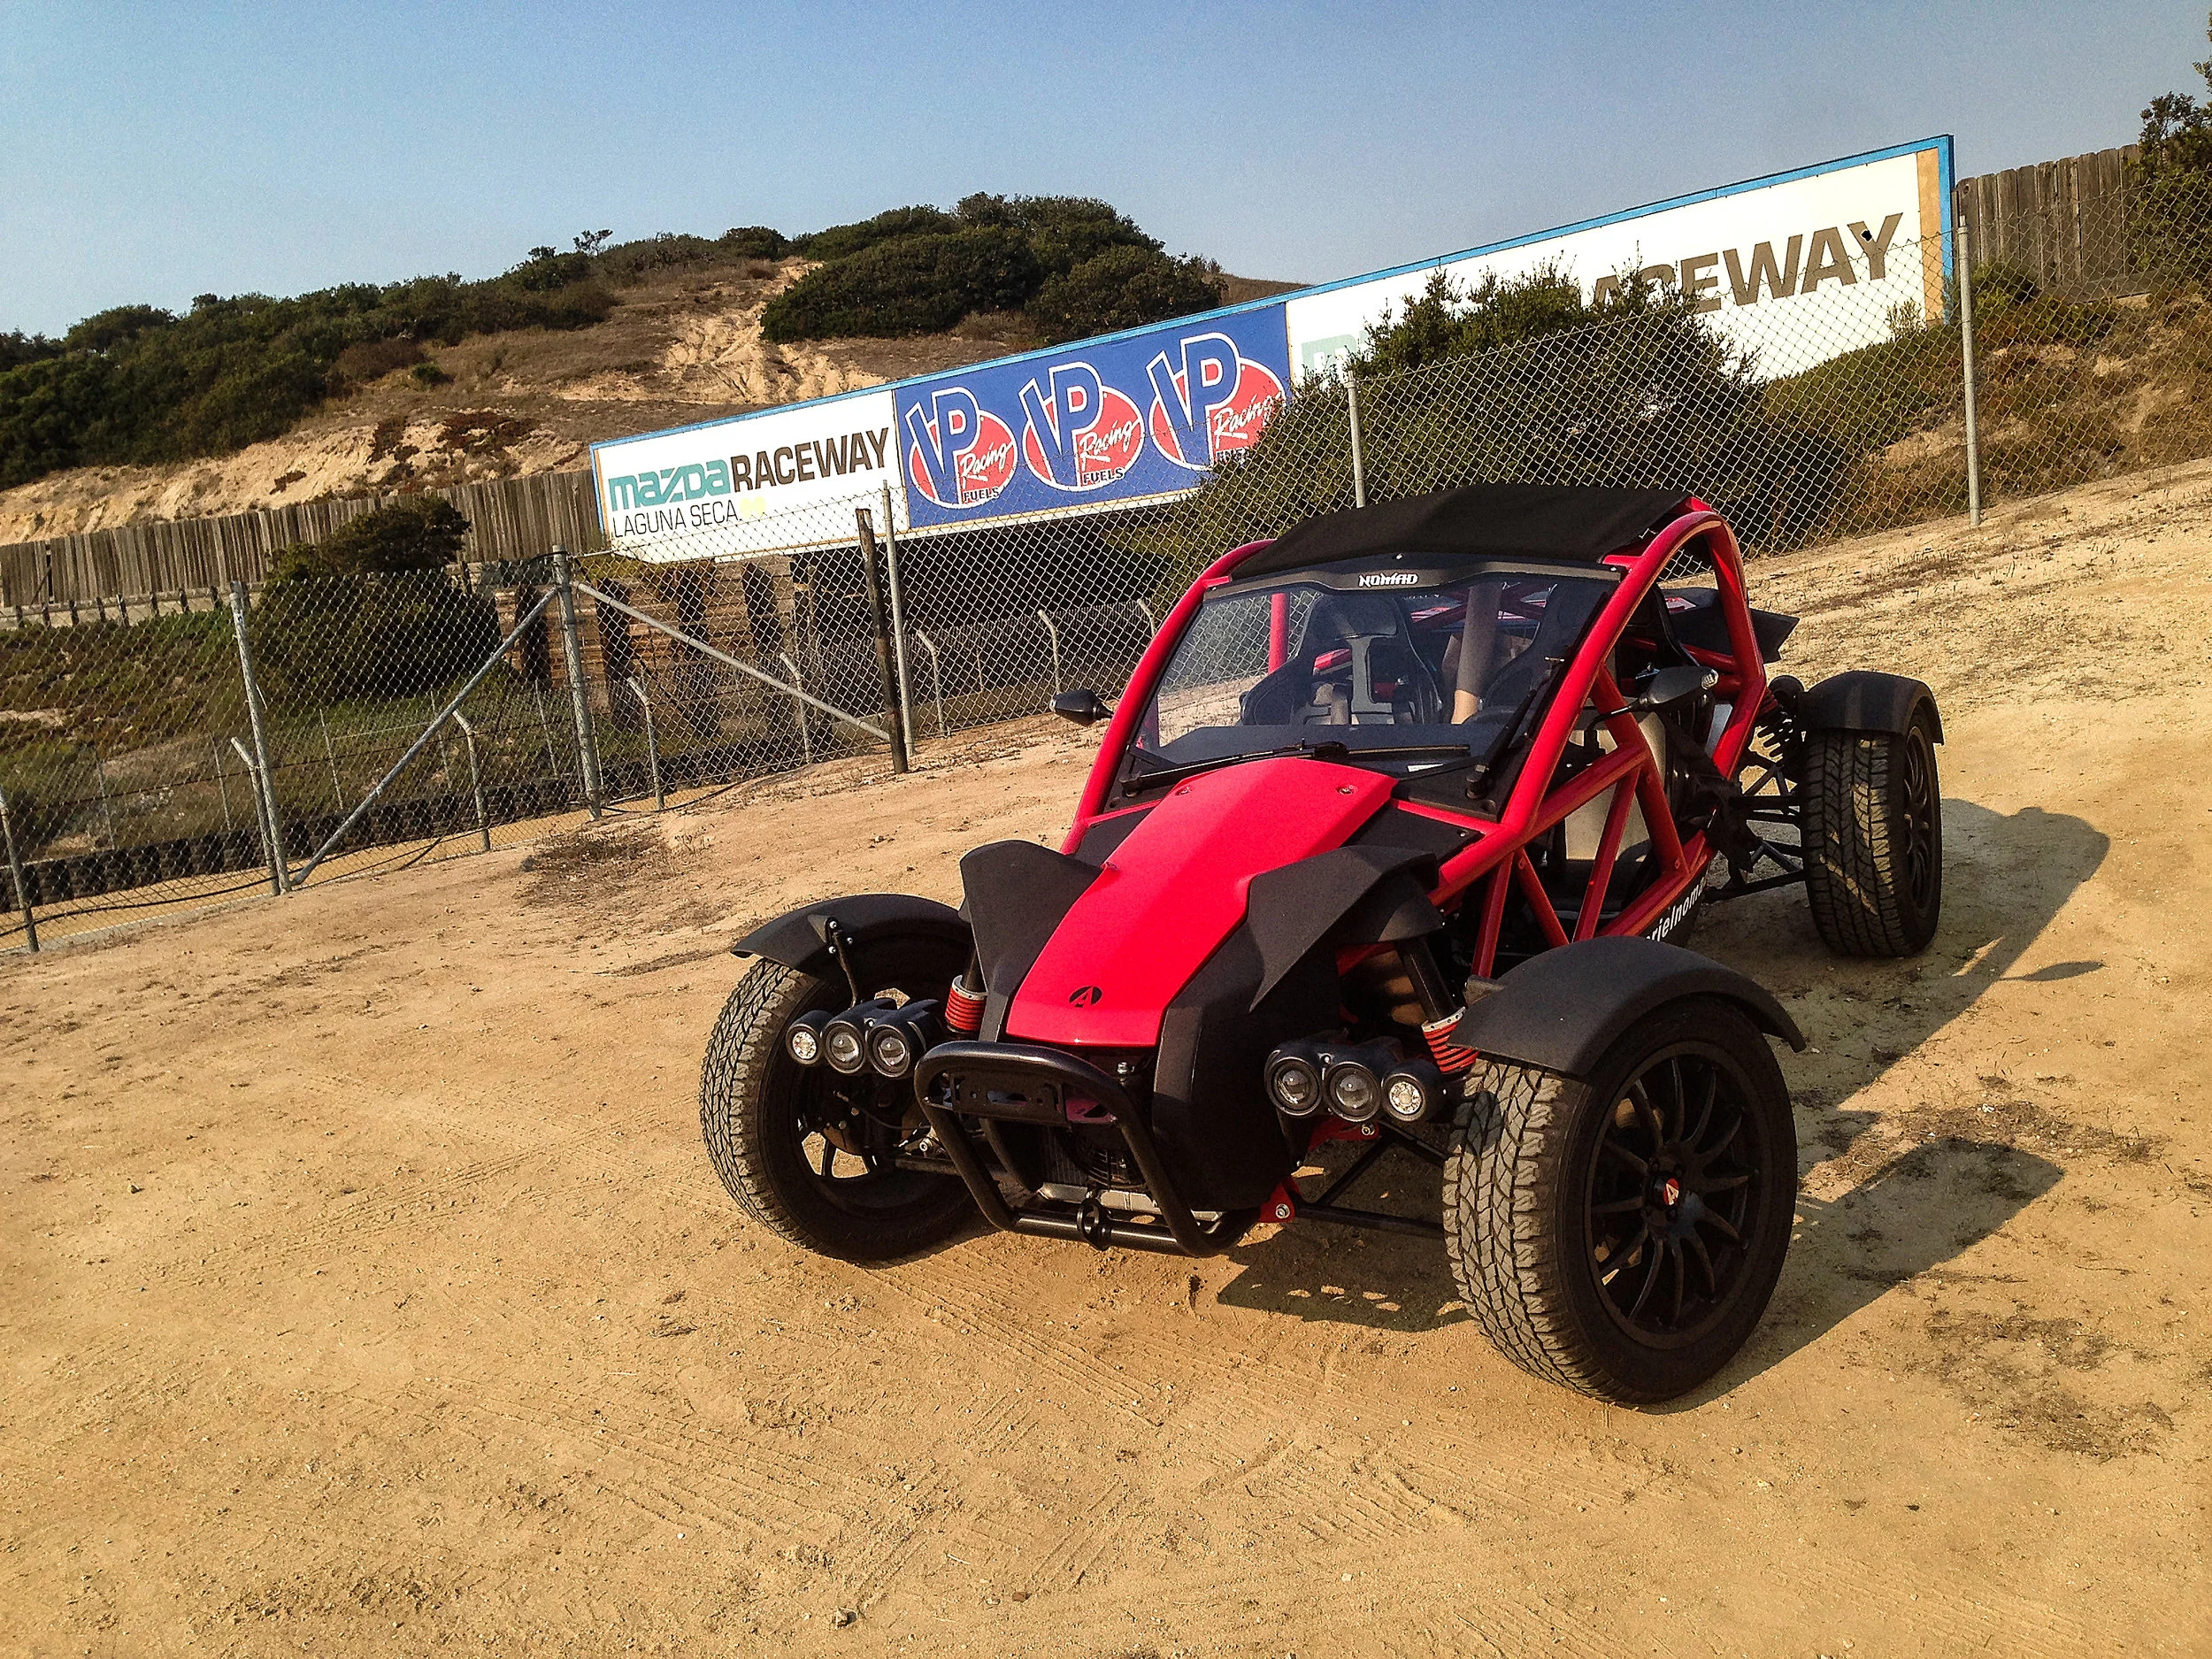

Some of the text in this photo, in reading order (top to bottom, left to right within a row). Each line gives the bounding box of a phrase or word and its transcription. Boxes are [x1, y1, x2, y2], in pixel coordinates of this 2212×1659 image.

[730, 427, 889, 493] RACEWAY
[1079, 419, 1138, 472] Racing
[959, 442, 1013, 489] Racing
[1082, 466, 1125, 485] FUELS
[963, 487, 1001, 503] FUELS
[612, 499, 739, 538] LAGUNA SECA
[1357, 572, 1419, 588] NOMAD
